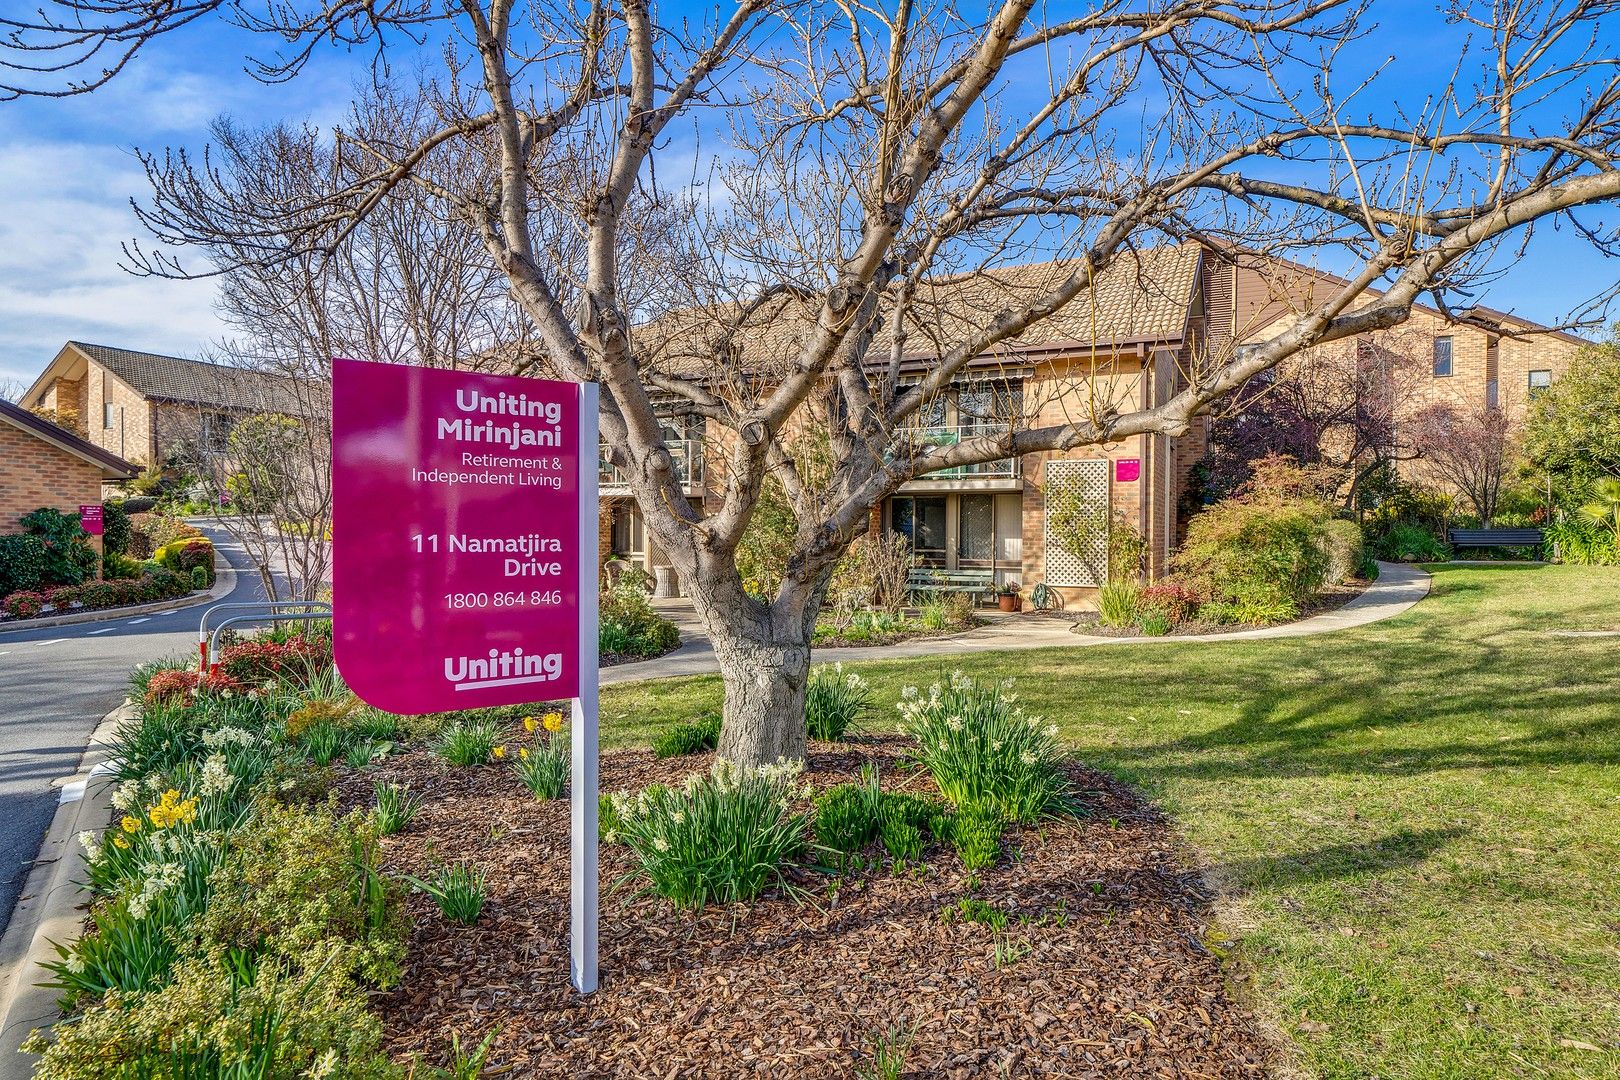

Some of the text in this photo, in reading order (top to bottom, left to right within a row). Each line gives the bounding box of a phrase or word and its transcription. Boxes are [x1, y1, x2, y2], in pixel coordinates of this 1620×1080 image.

[456, 389, 561, 424] Uniting
[438, 417, 561, 450] Mirinjani
[462, 452, 562, 470] Retirement &
[412, 468, 562, 489] Independent Living
[411, 534, 562, 557] 11 Namatjira
[504, 558, 562, 577] Drive
[444, 590, 562, 609] 1800 864 846
[444, 648, 562, 682] Uniting
